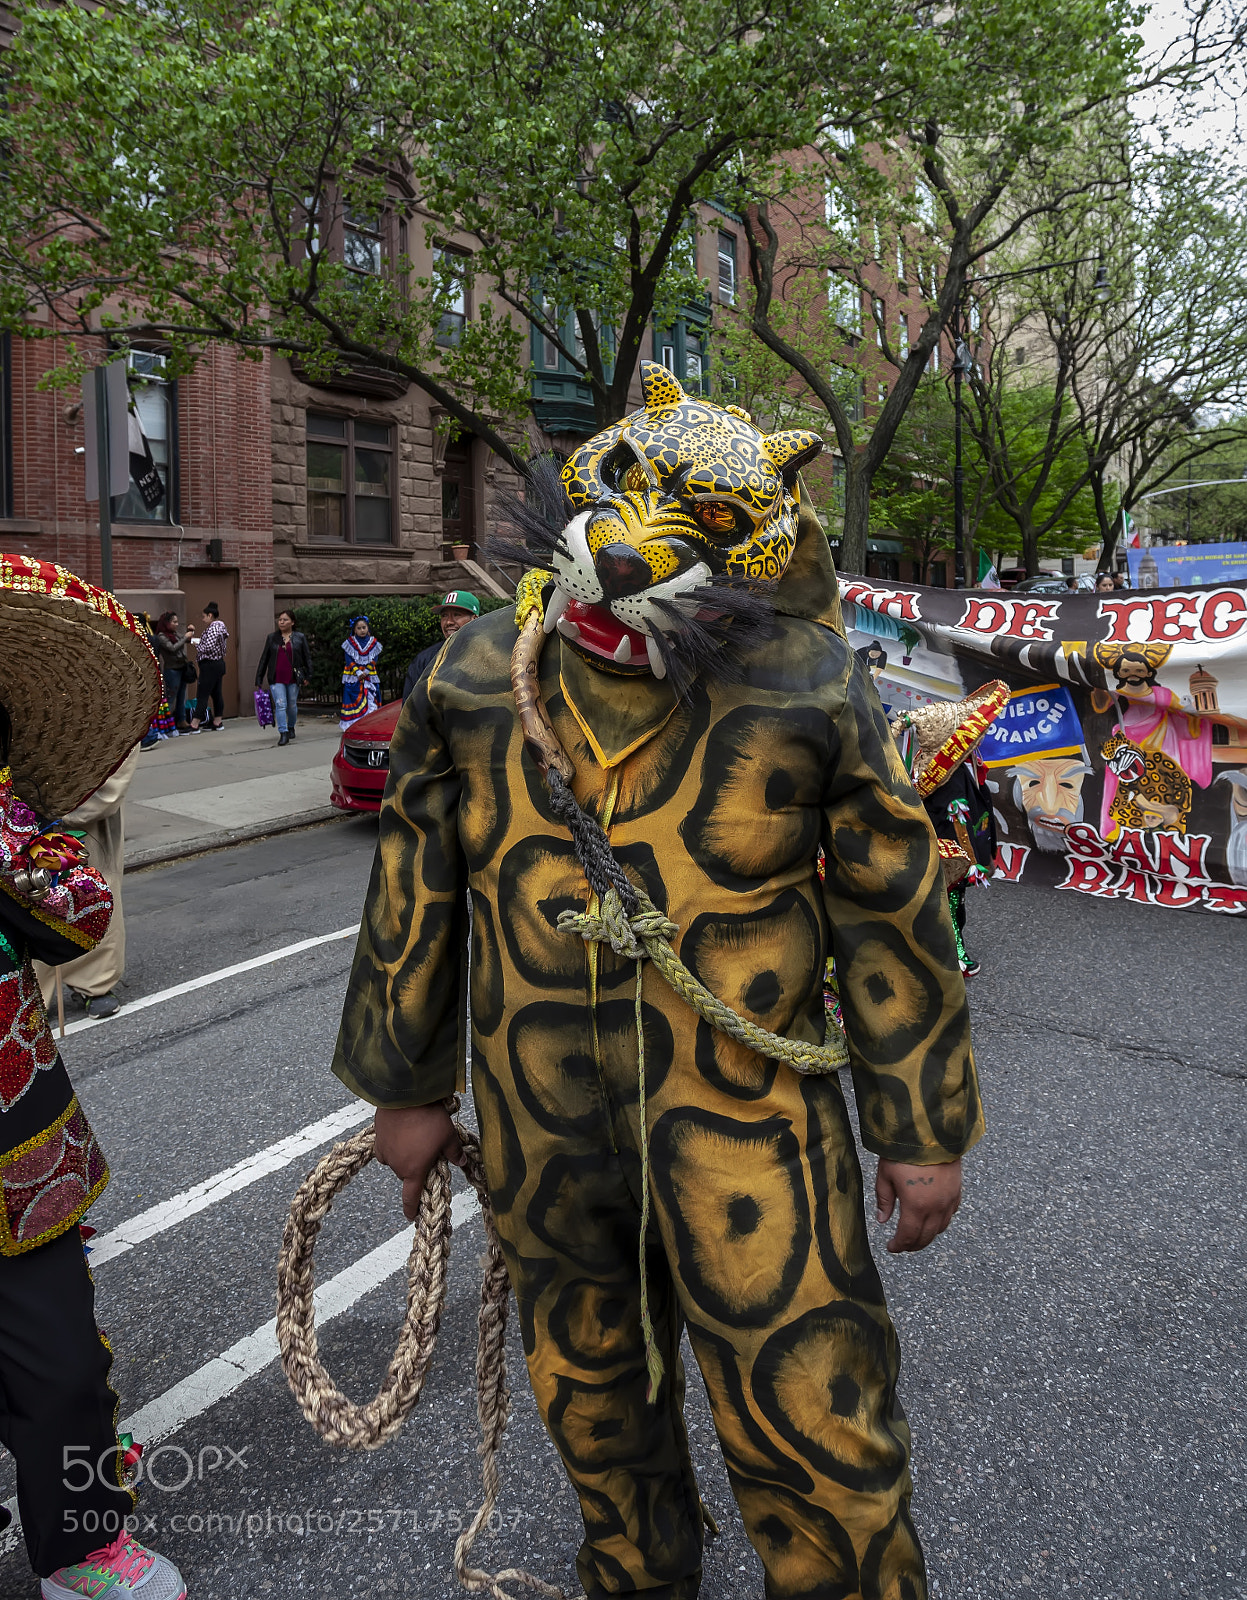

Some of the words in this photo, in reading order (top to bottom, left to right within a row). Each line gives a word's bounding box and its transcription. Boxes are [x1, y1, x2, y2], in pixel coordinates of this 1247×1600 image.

[956, 599, 1060, 640] DE
[1099, 592, 1247, 643] TEC
[940, 710, 989, 762] SAN
[1065, 823, 1211, 881] SAN
